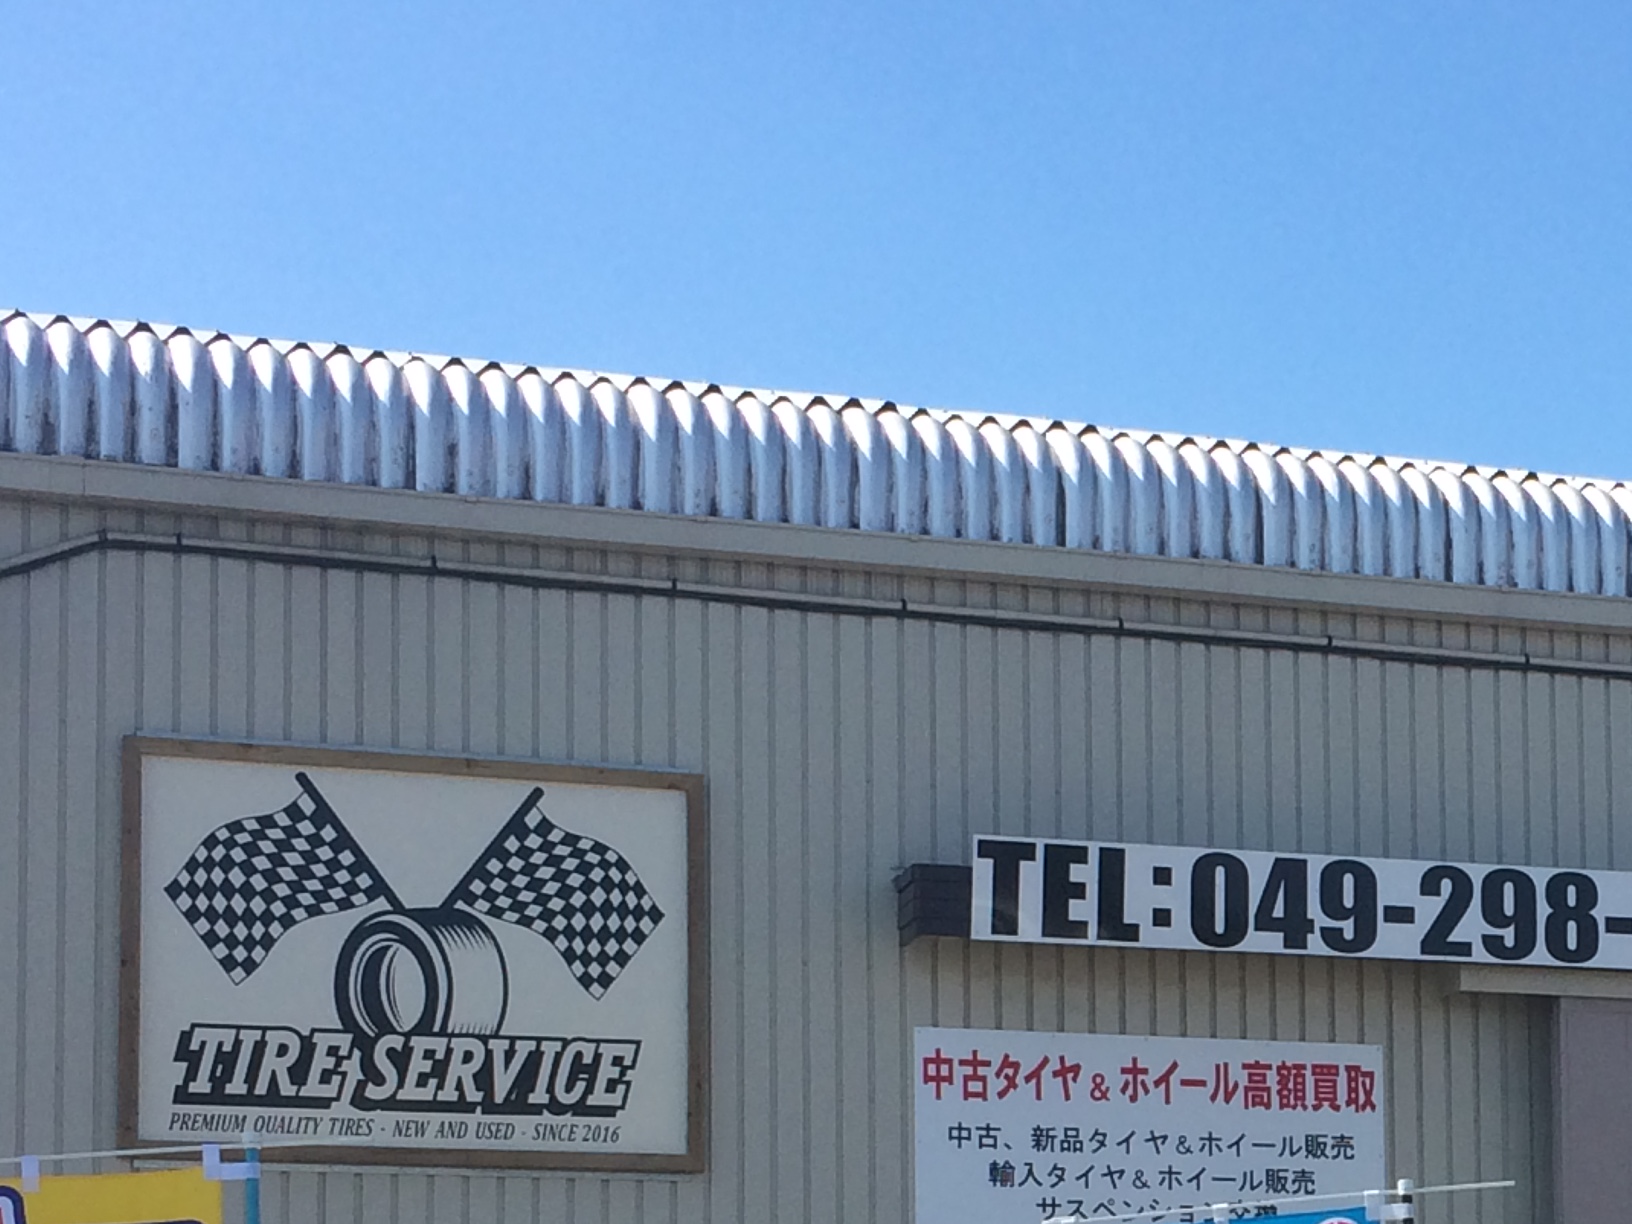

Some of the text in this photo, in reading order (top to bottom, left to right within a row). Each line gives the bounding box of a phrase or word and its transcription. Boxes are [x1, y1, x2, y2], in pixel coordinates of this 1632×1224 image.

[180, 1025, 640, 1112] TIRE SERVICE
[168, 1113, 246, 1134] PREMIUM
[253, 1115, 324, 1136] QUALITY
[328, 1117, 375, 1137] TIRES
[392, 1119, 431, 1139] NEW
[434, 1120, 469, 1140] AND
[474, 1121, 517, 1141] USED
[531, 1122, 579, 1143] SINCE
[581, 1123, 622, 1144] 2016
